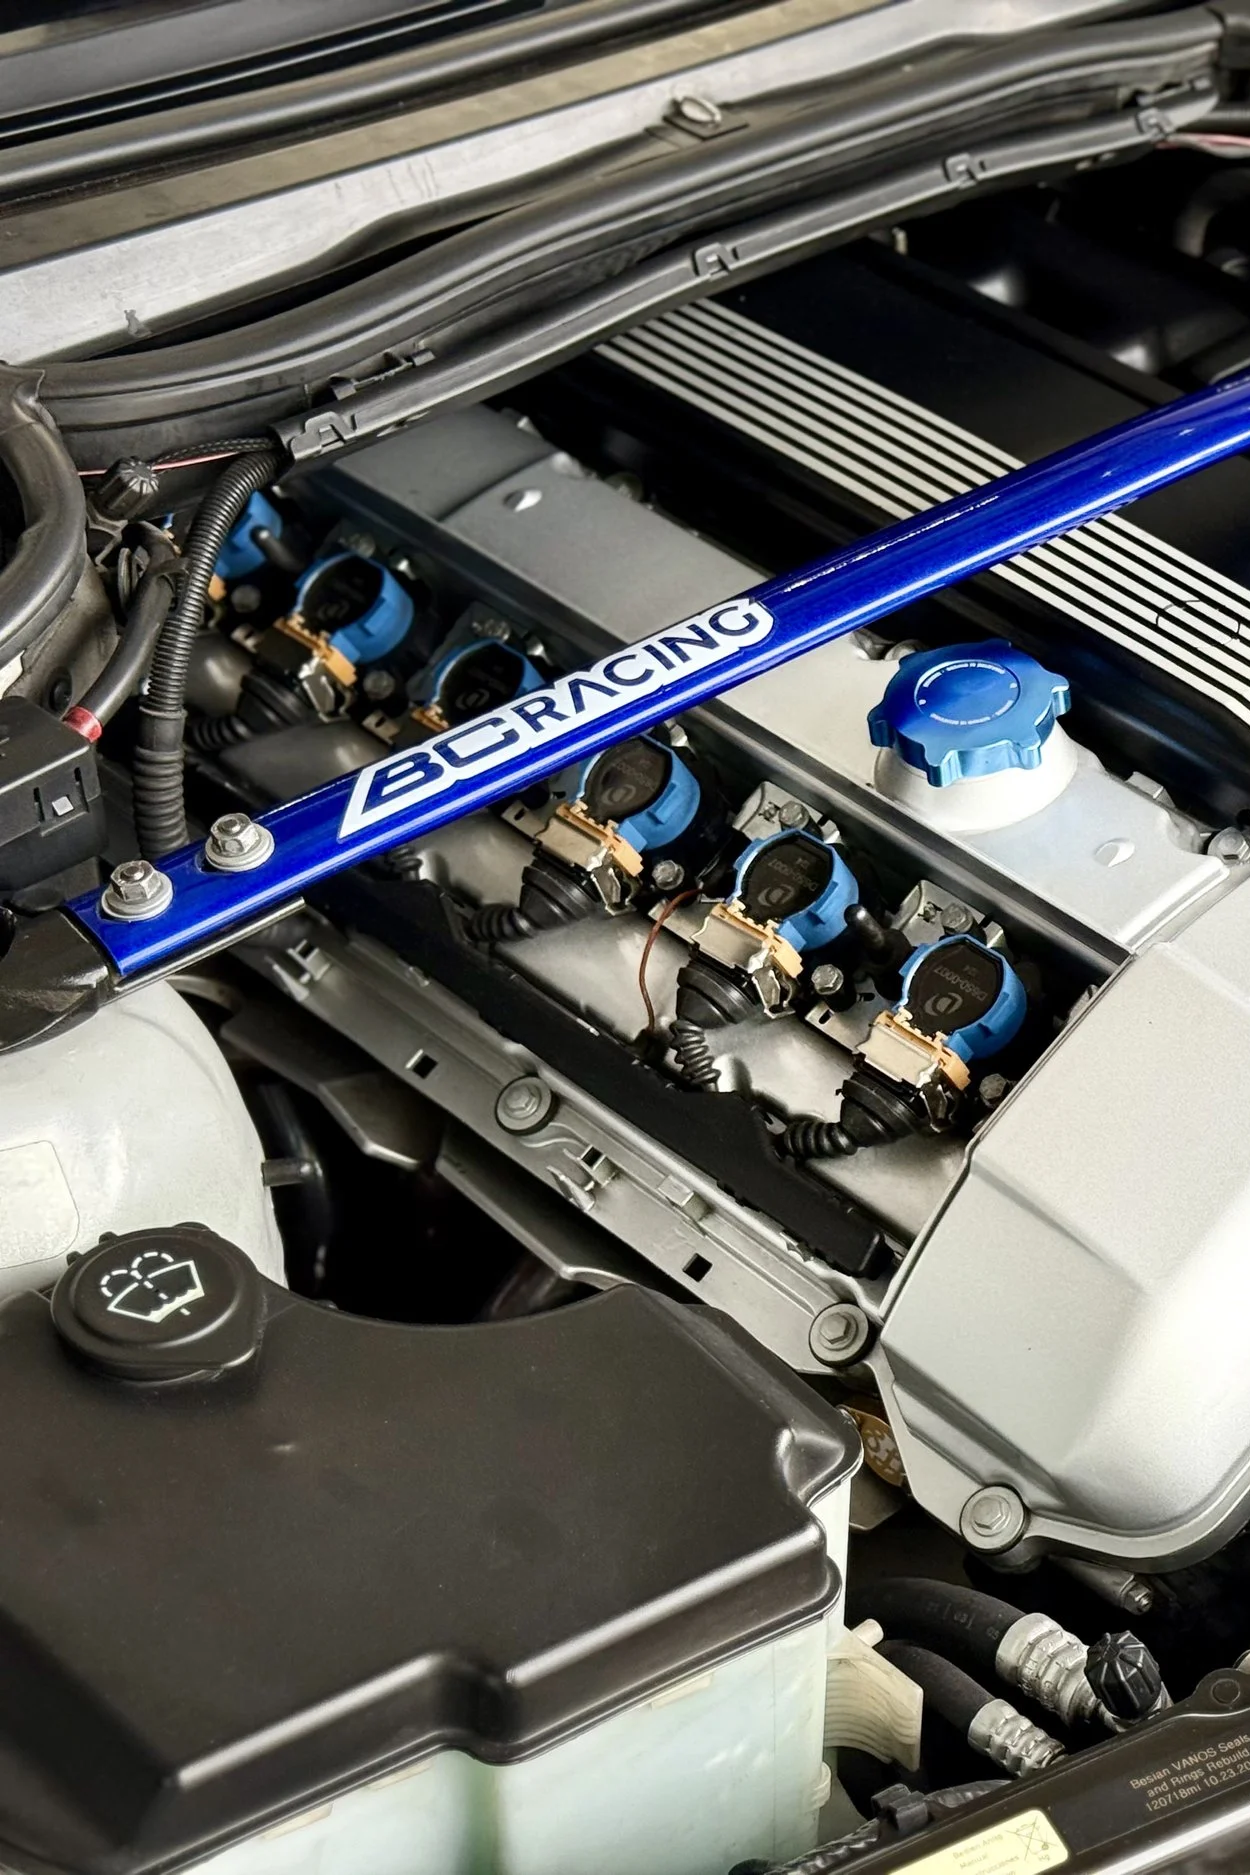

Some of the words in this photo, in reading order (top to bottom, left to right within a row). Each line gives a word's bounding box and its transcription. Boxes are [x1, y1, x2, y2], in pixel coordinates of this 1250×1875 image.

[361, 717, 520, 814] BC
[511, 604, 760, 732] RACING
[1147, 1782, 1169, 1797] and
[1171, 1768, 1205, 1786] Rings
[1207, 1748, 1250, 1771] Rebuild
[1171, 1747, 1217, 1771] VANOS
[1145, 1784, 1202, 1812] 120718mi
